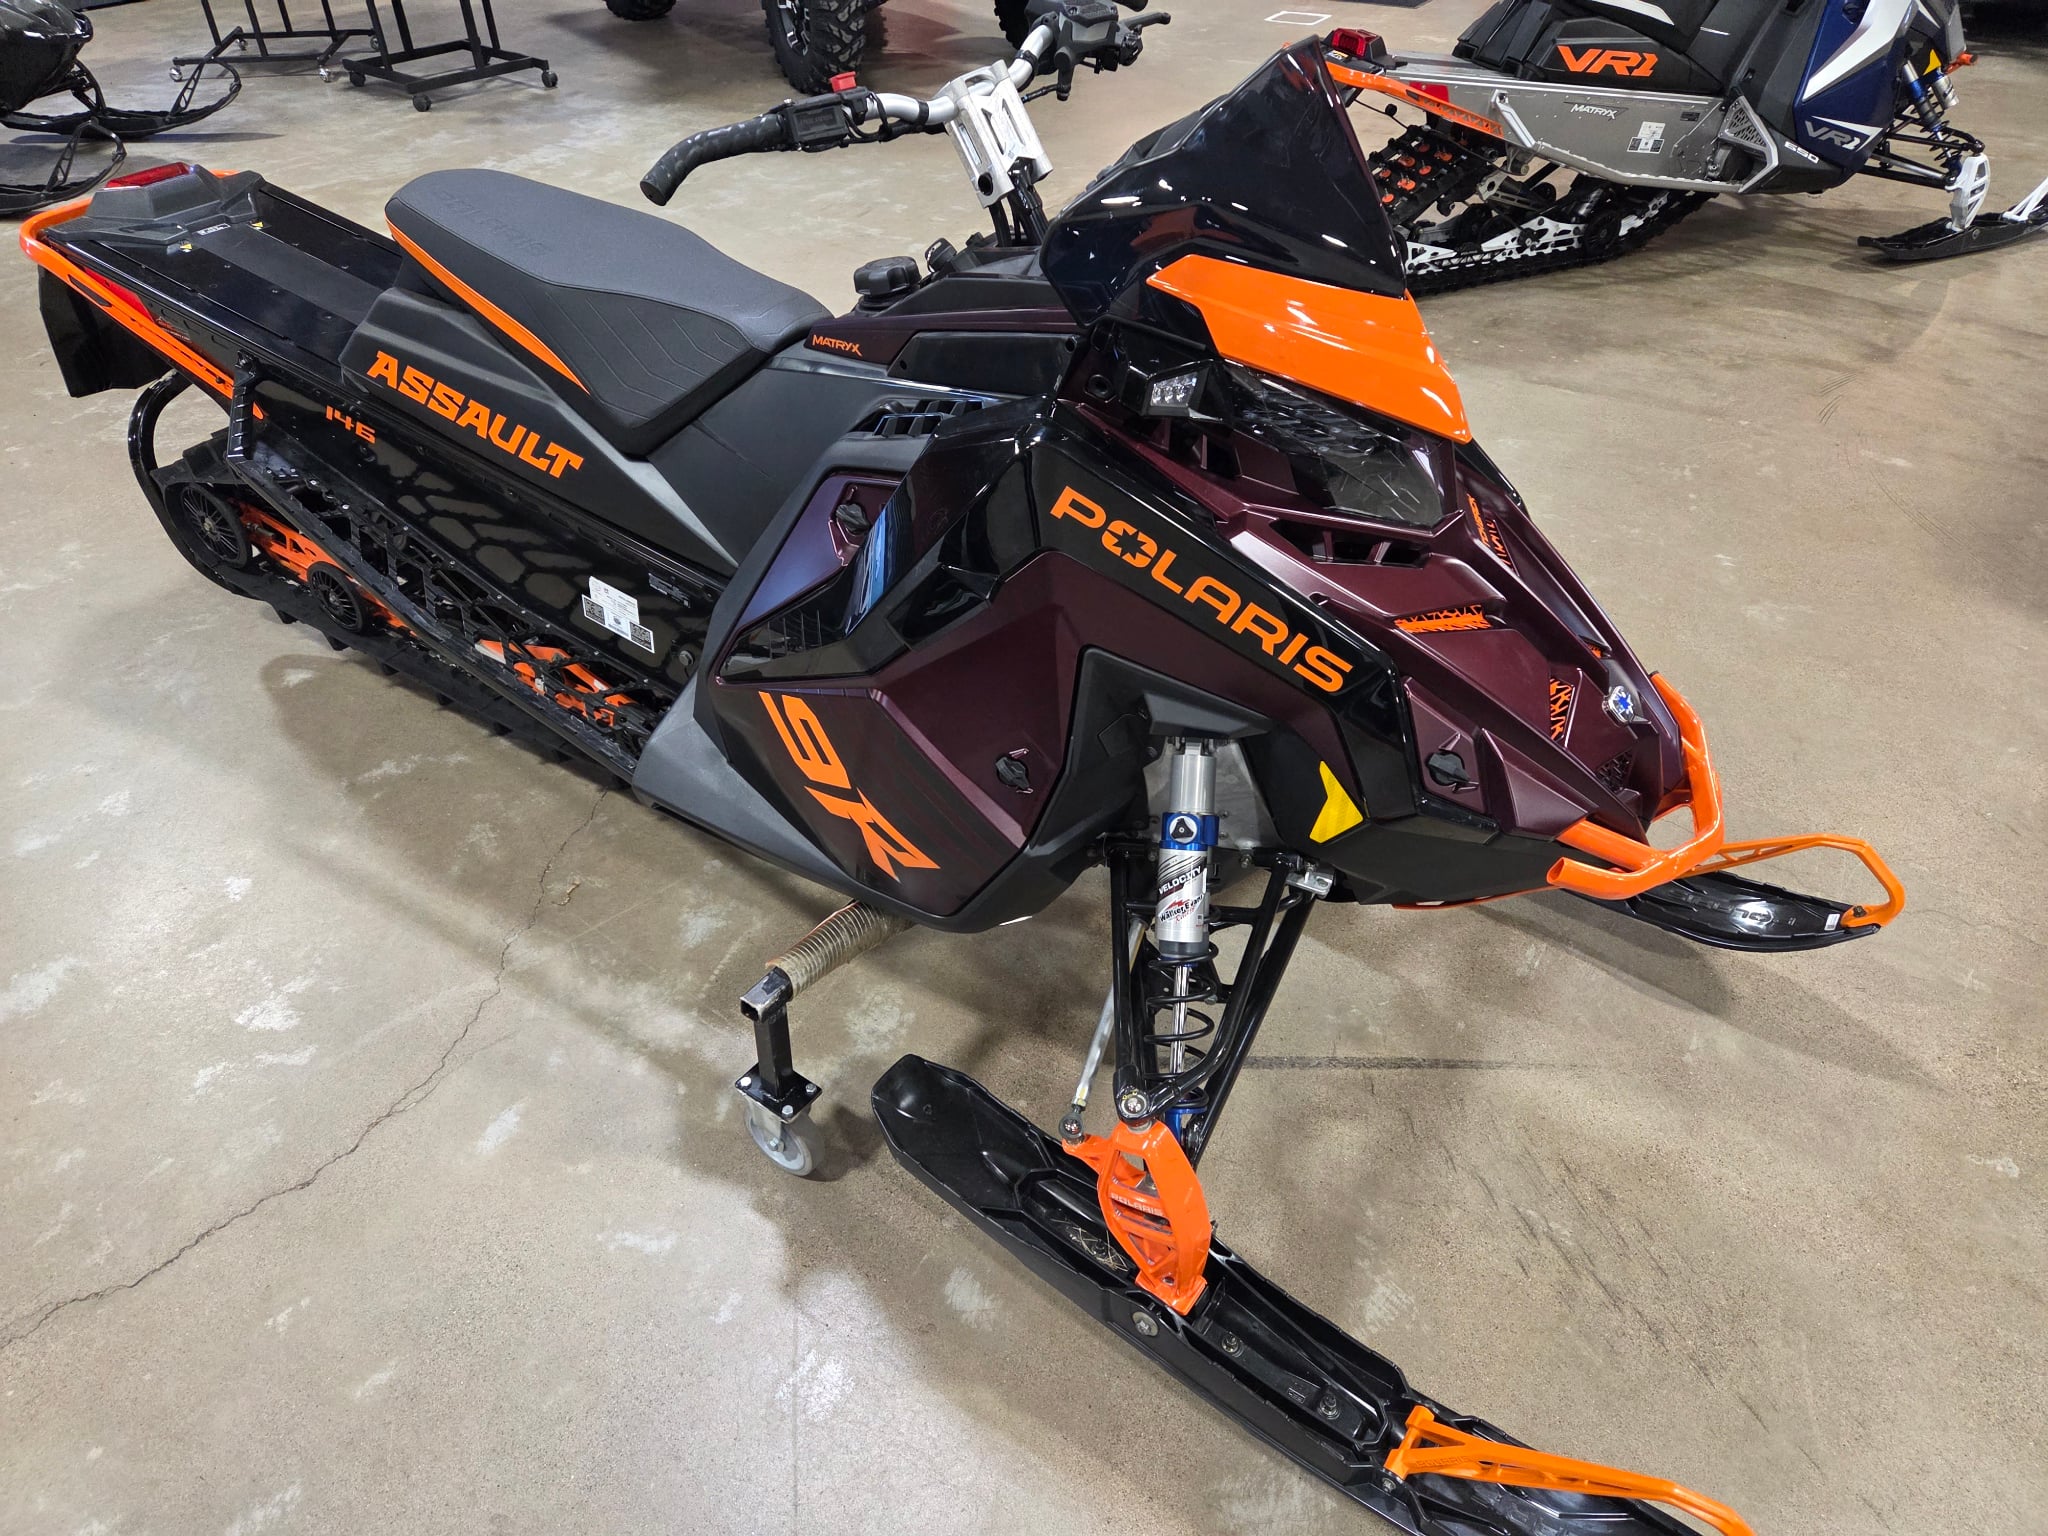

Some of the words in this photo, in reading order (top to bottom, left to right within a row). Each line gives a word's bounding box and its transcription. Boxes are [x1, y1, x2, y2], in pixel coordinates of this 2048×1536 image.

[1557, 45, 1658, 77] VR1
[1571, 103, 1618, 119] MATRYX
[1804, 120, 1860, 150] VR1
[812, 334, 863, 357] MATRYX
[326, 405, 376, 444] 146
[367, 350, 584, 479] ASSAULT
[1050, 485, 1353, 692] POLARIS
[1159, 866, 1201, 894] VELOCITY
